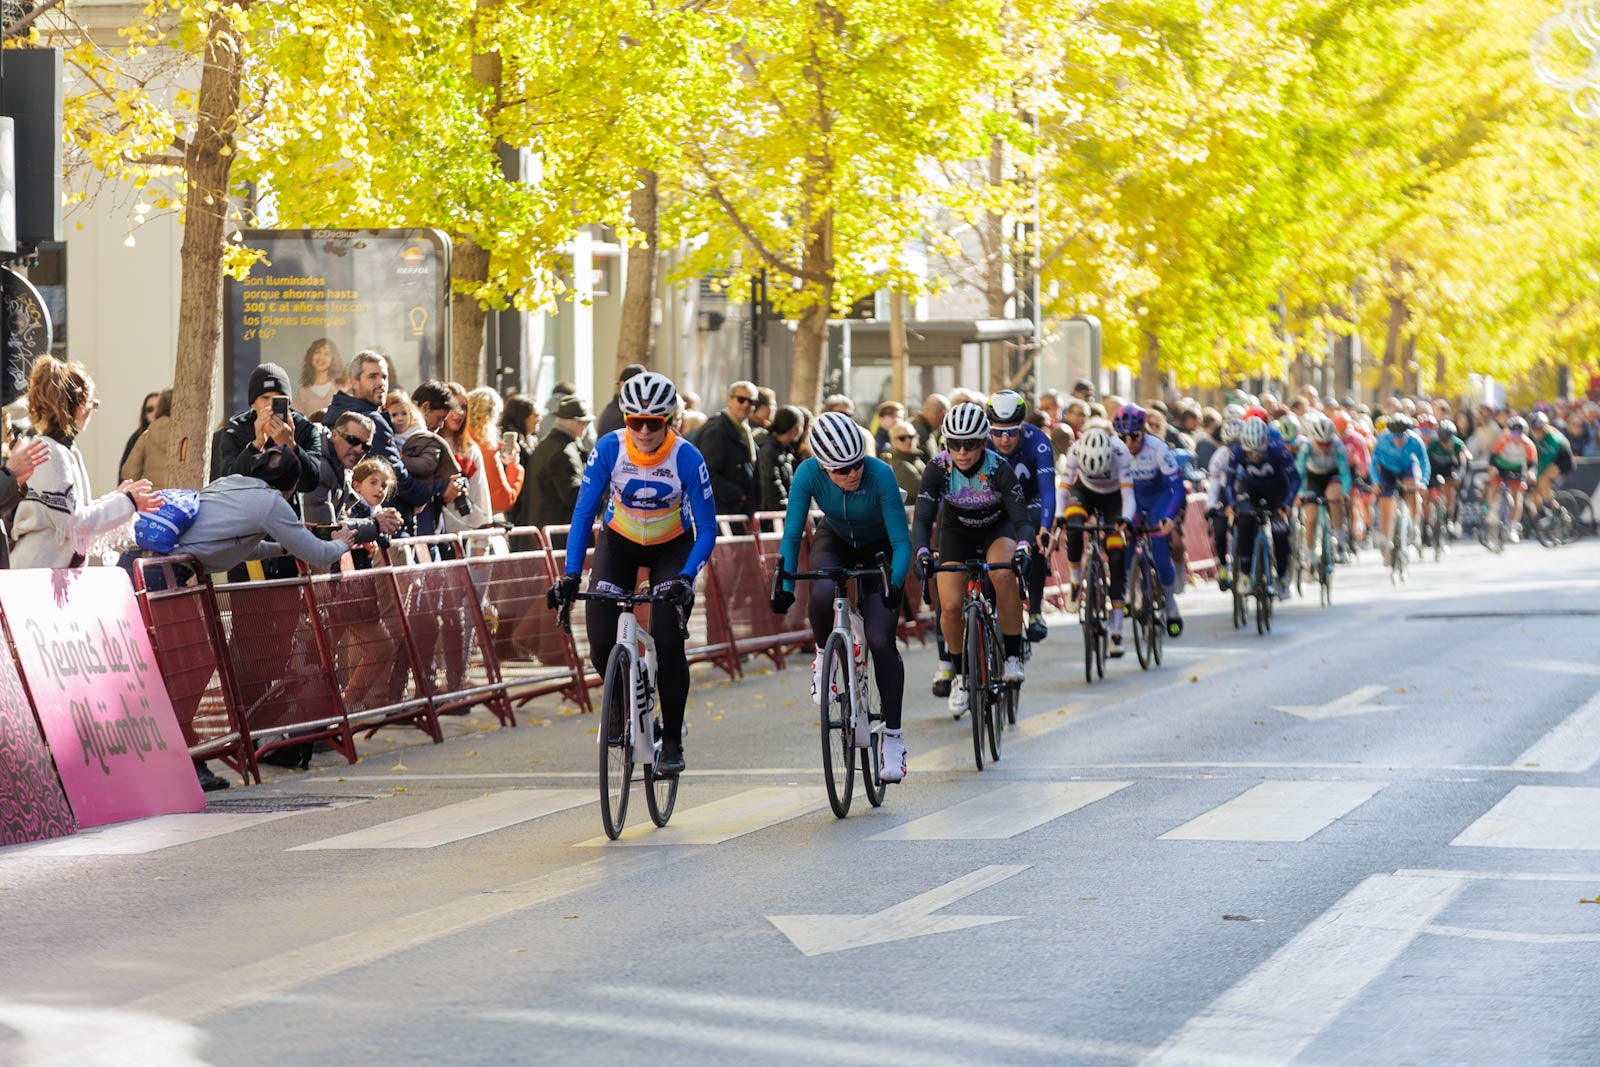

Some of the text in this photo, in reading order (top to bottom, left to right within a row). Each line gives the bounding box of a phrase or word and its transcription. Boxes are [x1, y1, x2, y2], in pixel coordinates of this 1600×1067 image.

[244, 276, 325, 286] Son iluminadas
[243, 289, 358, 301] porque ahorran hasta
[244, 302, 266, 312] 300
[268, 302, 276, 312] €
[279, 302, 289, 312] al
[293, 301, 312, 312] año
[315, 303, 328, 312] en
[243, 315, 260, 326] los
[262, 315, 298, 326] Planes
[258, 328, 276, 339] tú?
